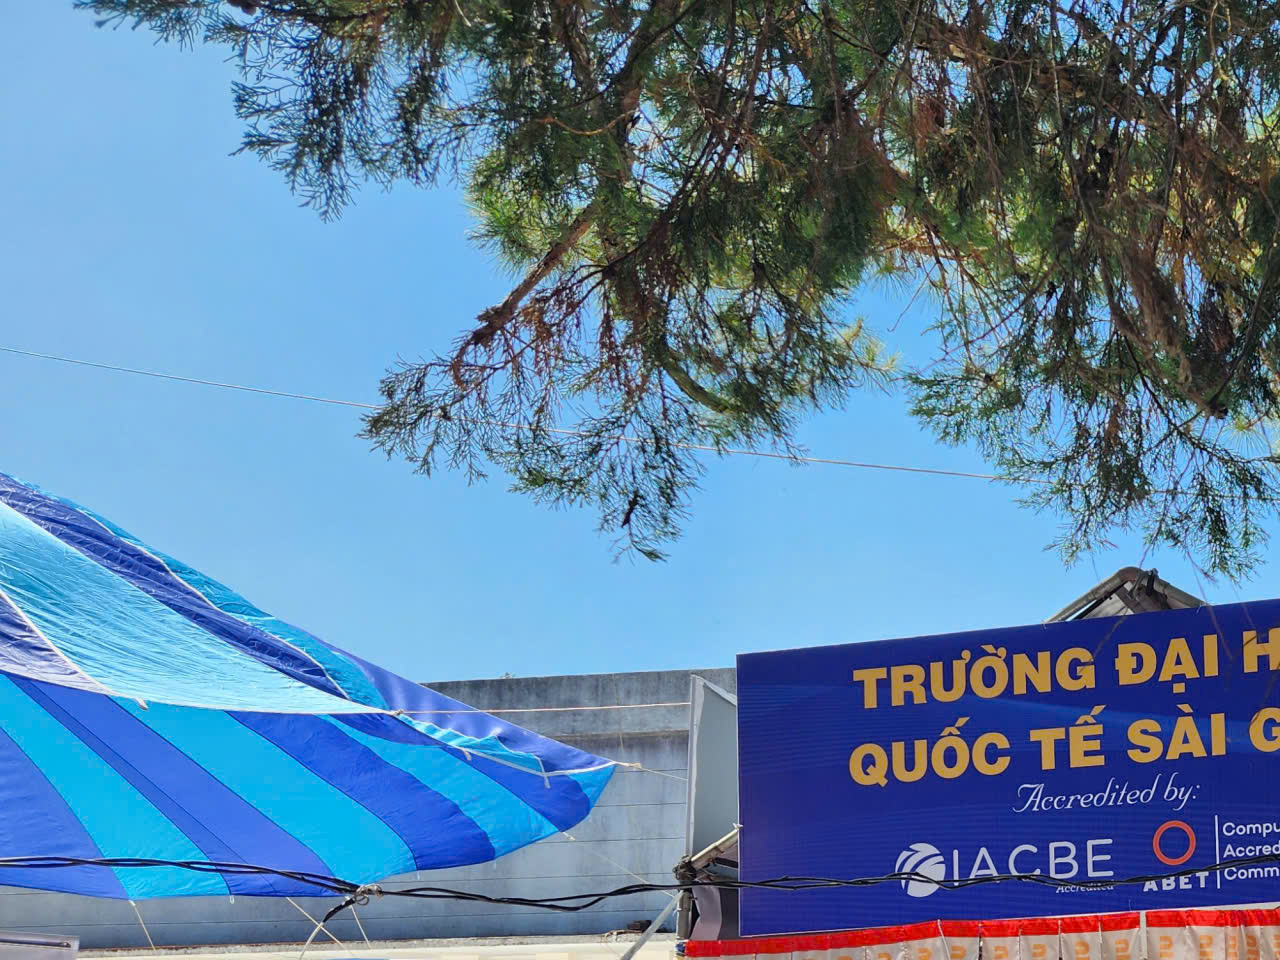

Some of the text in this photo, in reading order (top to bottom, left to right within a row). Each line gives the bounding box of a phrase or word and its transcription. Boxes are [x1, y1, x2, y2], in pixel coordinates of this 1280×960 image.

[853, 645, 1095, 709] TRƯỜNG
[1115, 634, 1218, 693] ĐẠI
[849, 717, 1011, 787] QUỐC
[1030, 705, 1106, 770] TẾ
[1127, 704, 1227, 763] SÀI
[1013, 772, 1201, 812] Accredited by:
[952, 838, 1114, 885] IACBE
[1143, 872, 1209, 892] ABET
